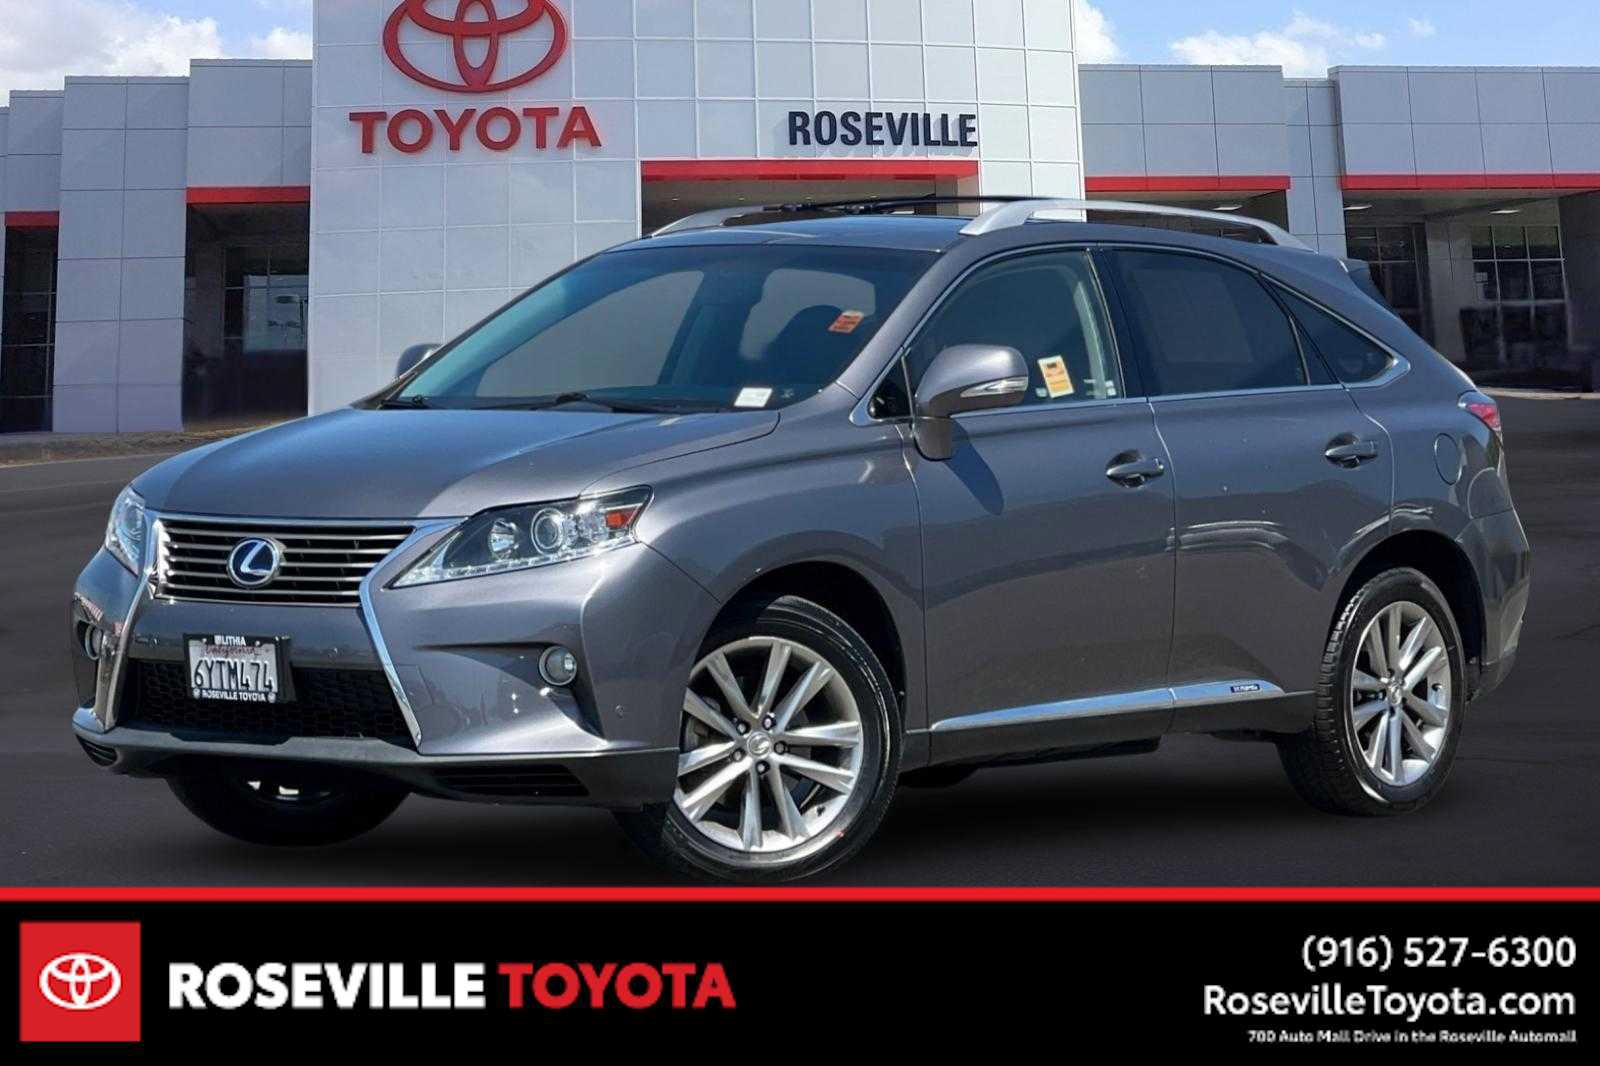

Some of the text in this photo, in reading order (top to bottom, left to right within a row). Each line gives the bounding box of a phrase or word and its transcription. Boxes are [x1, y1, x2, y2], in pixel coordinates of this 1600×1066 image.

[350, 106, 602, 153] TOYOTA
[788, 111, 978, 147] ROSEVILLE
[223, 635, 247, 646] LITHIA
[194, 659, 272, 690] 6YTM474
[202, 689, 266, 702] ROSEVILLE TOYOTA
